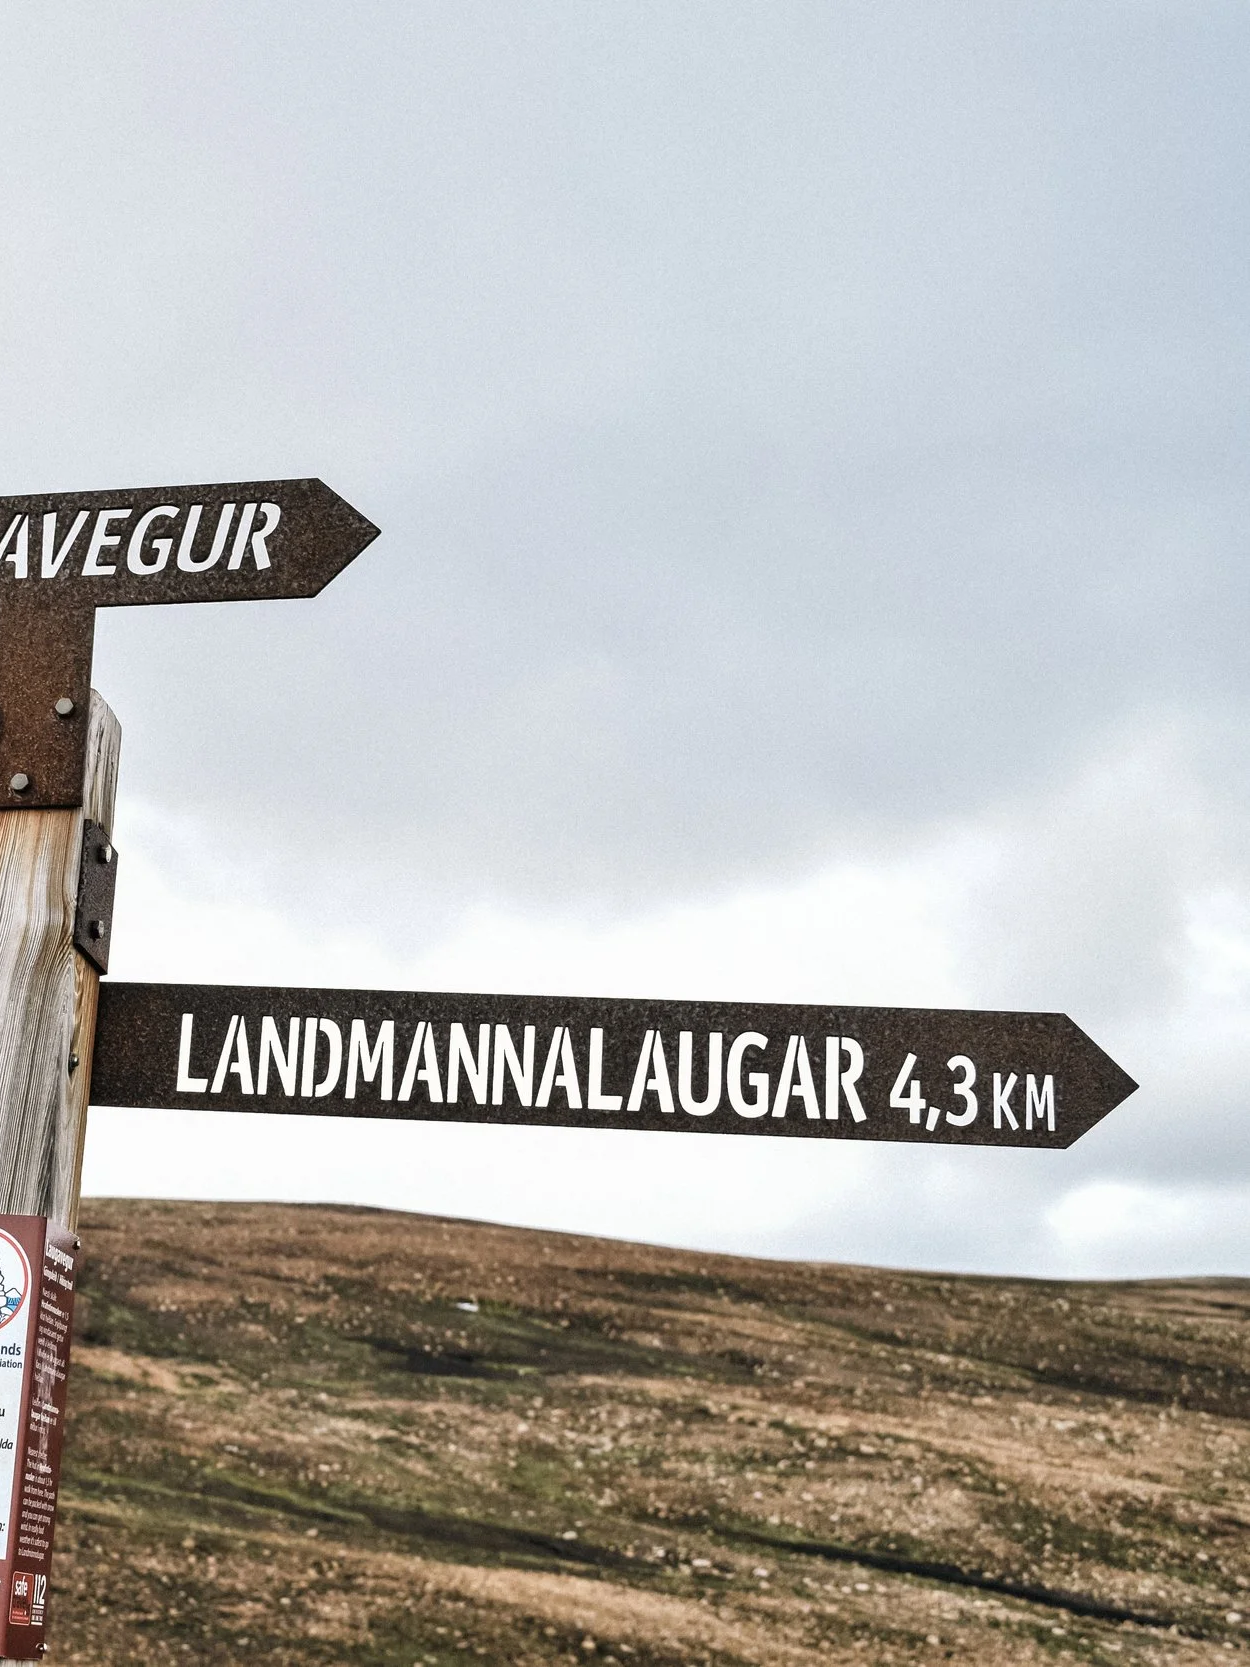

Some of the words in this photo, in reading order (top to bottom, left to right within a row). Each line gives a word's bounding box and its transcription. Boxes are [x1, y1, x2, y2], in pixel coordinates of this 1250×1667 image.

[176, 1013, 867, 1124] LANDMANNALAUGAR
[888, 1053, 979, 1133] 4,3
[992, 1071, 1057, 1132] KM
[14, 1576, 28, 1596] safe
[33, 1574, 47, 1605] 112
